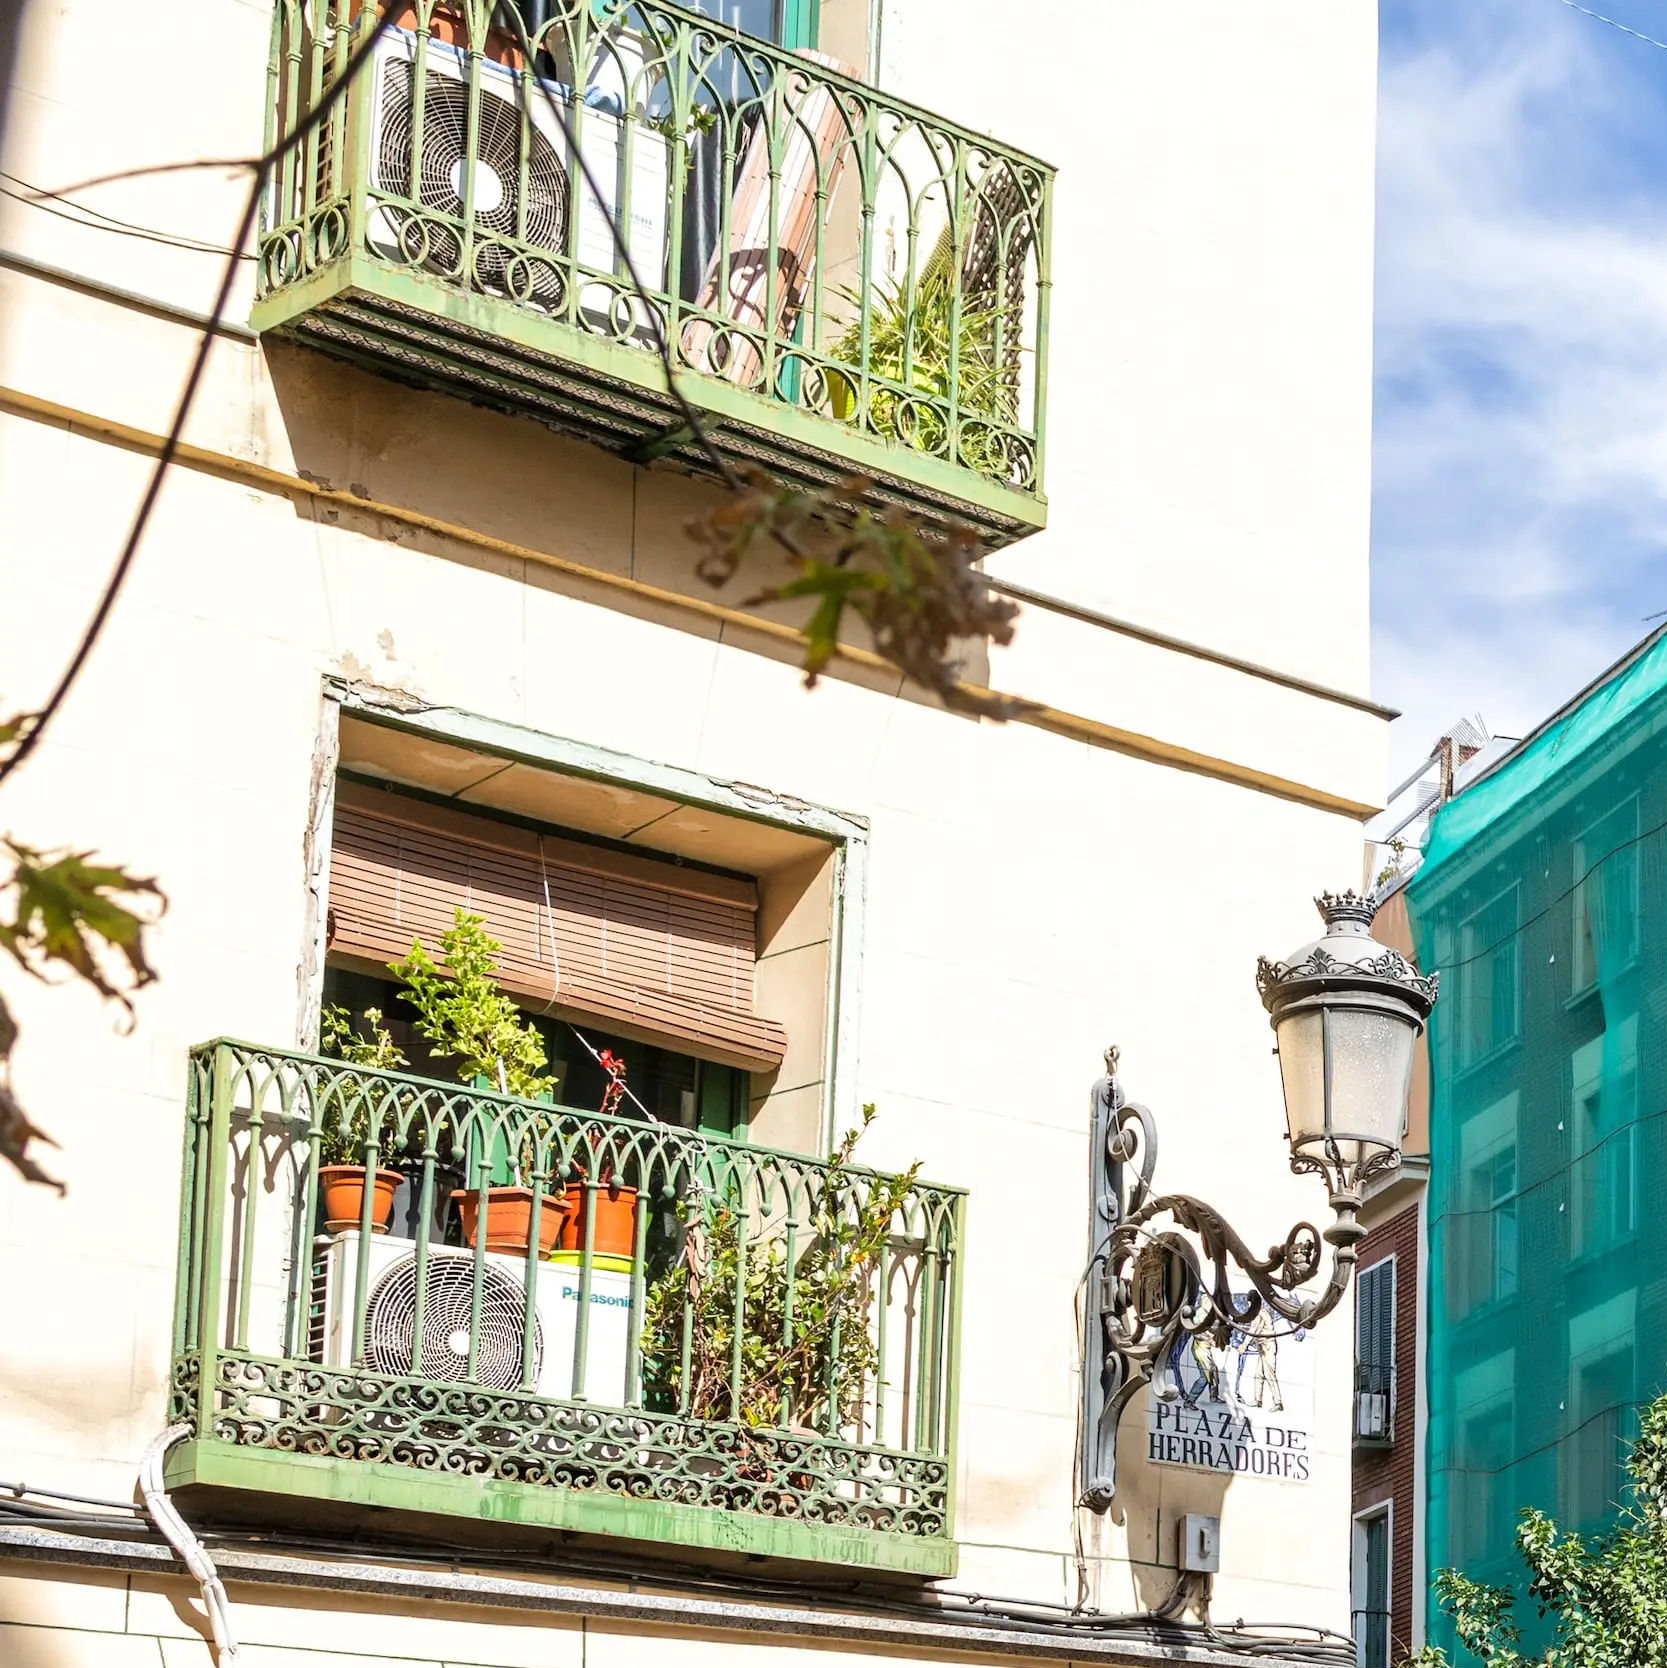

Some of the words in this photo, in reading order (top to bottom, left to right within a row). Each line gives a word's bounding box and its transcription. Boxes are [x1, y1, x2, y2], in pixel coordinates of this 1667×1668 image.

[1156, 1401, 1257, 1444] PLAZA
[1265, 1427, 1307, 1451] DE
[1148, 1432, 1311, 1481] HERRADORES
